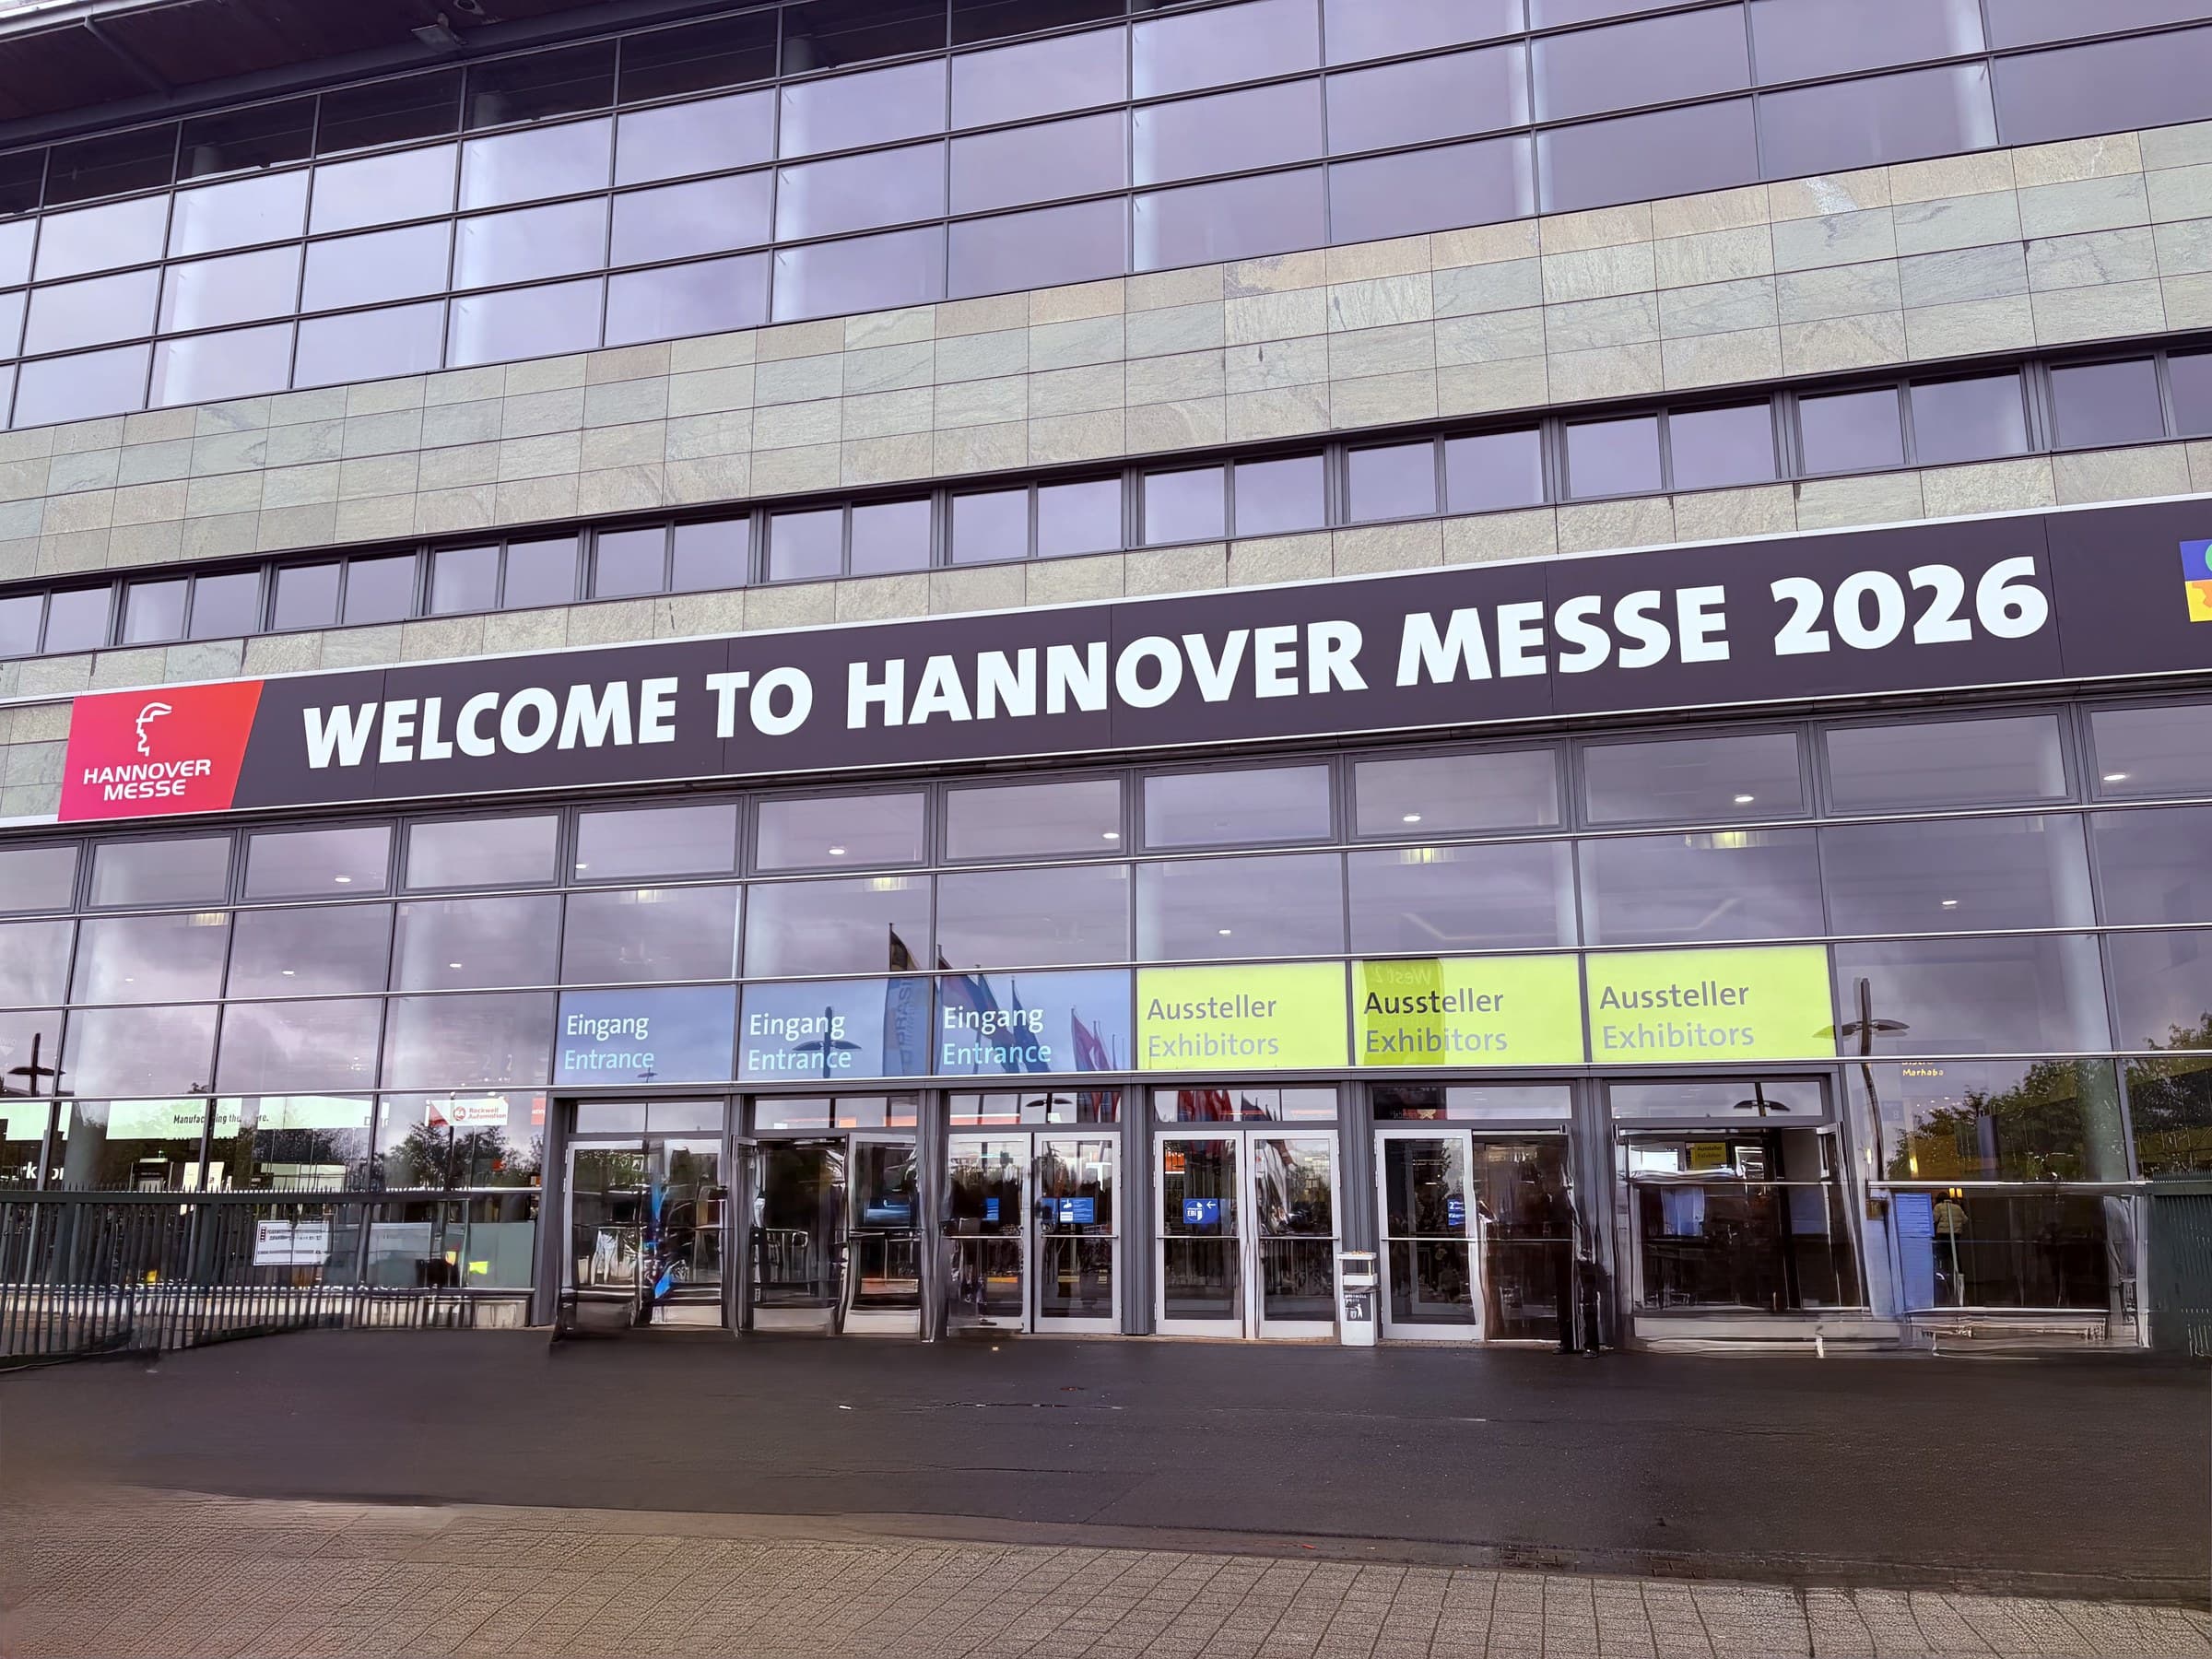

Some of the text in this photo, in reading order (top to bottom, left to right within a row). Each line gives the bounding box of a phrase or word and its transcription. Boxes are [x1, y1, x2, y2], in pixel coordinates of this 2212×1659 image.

[303, 556, 2049, 769] WELCOME TO HANNOVER MESSE 2026
[83, 759, 211, 784] HANNOVER
[103, 779, 186, 801] MESSE
[1147, 994, 1277, 1020] Aussteller
[1364, 987, 1503, 1014] Aussteller
[1599, 981, 1749, 1009] Aussteller
[567, 1014, 649, 1041] Eingang
[750, 1013, 845, 1041] Eingang
[944, 1006, 1044, 1035] Eingang
[1148, 1032, 1279, 1057] Exhibitors
[1366, 1027, 1508, 1053] Exhibitors
[1603, 1022, 1755, 1049] Exhibitors
[564, 1049, 654, 1070] Entrance
[748, 1049, 852, 1070] Entrance
[943, 1042, 1052, 1065] Entrance
[173, 1114, 227, 1124] Manufacing
